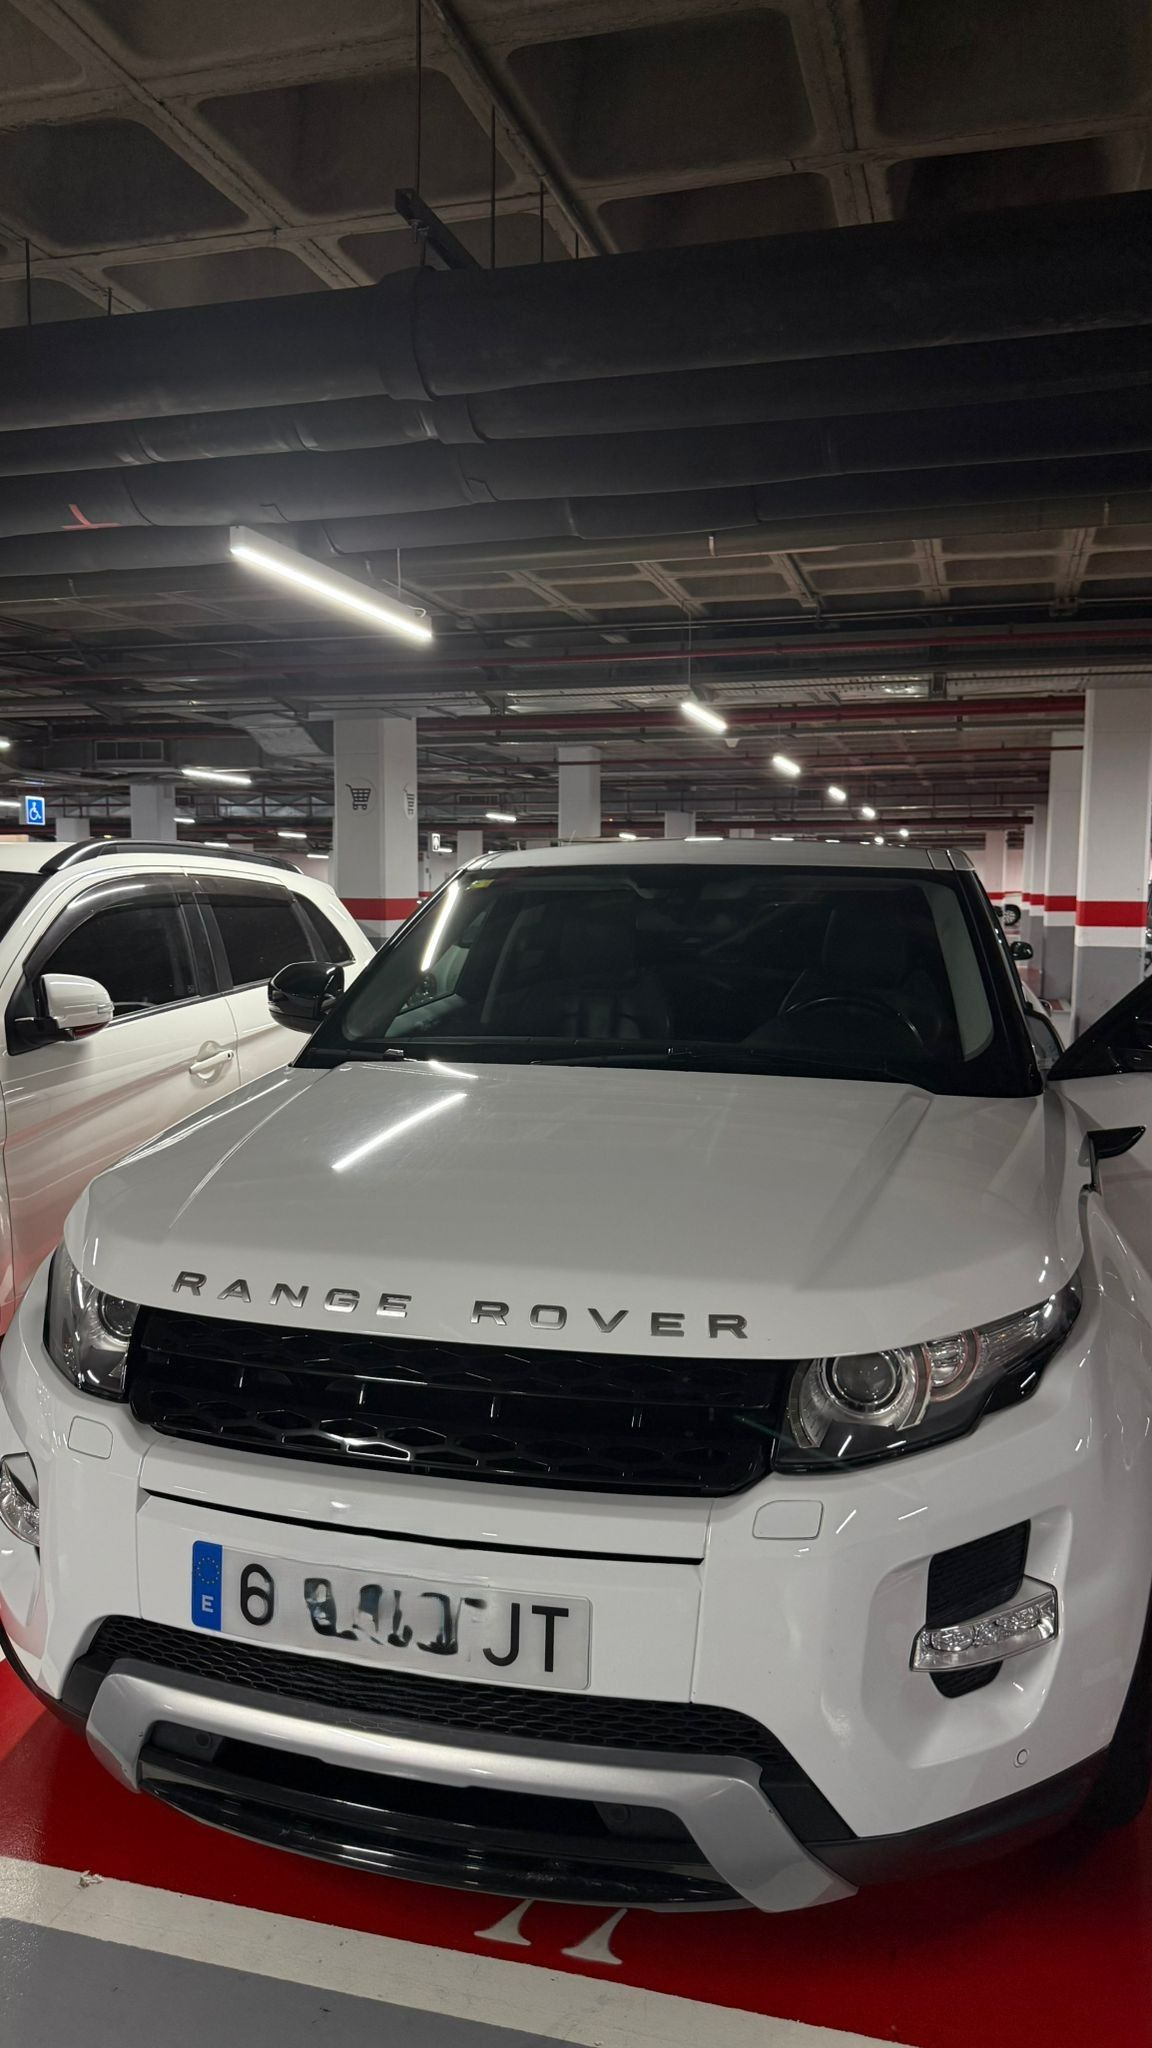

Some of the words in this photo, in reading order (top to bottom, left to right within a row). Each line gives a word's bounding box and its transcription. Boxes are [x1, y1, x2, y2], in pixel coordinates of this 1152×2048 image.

[172, 1270, 412, 1318] RANGE
[471, 1300, 748, 1340] ROVER
[201, 1594, 214, 1613] E
